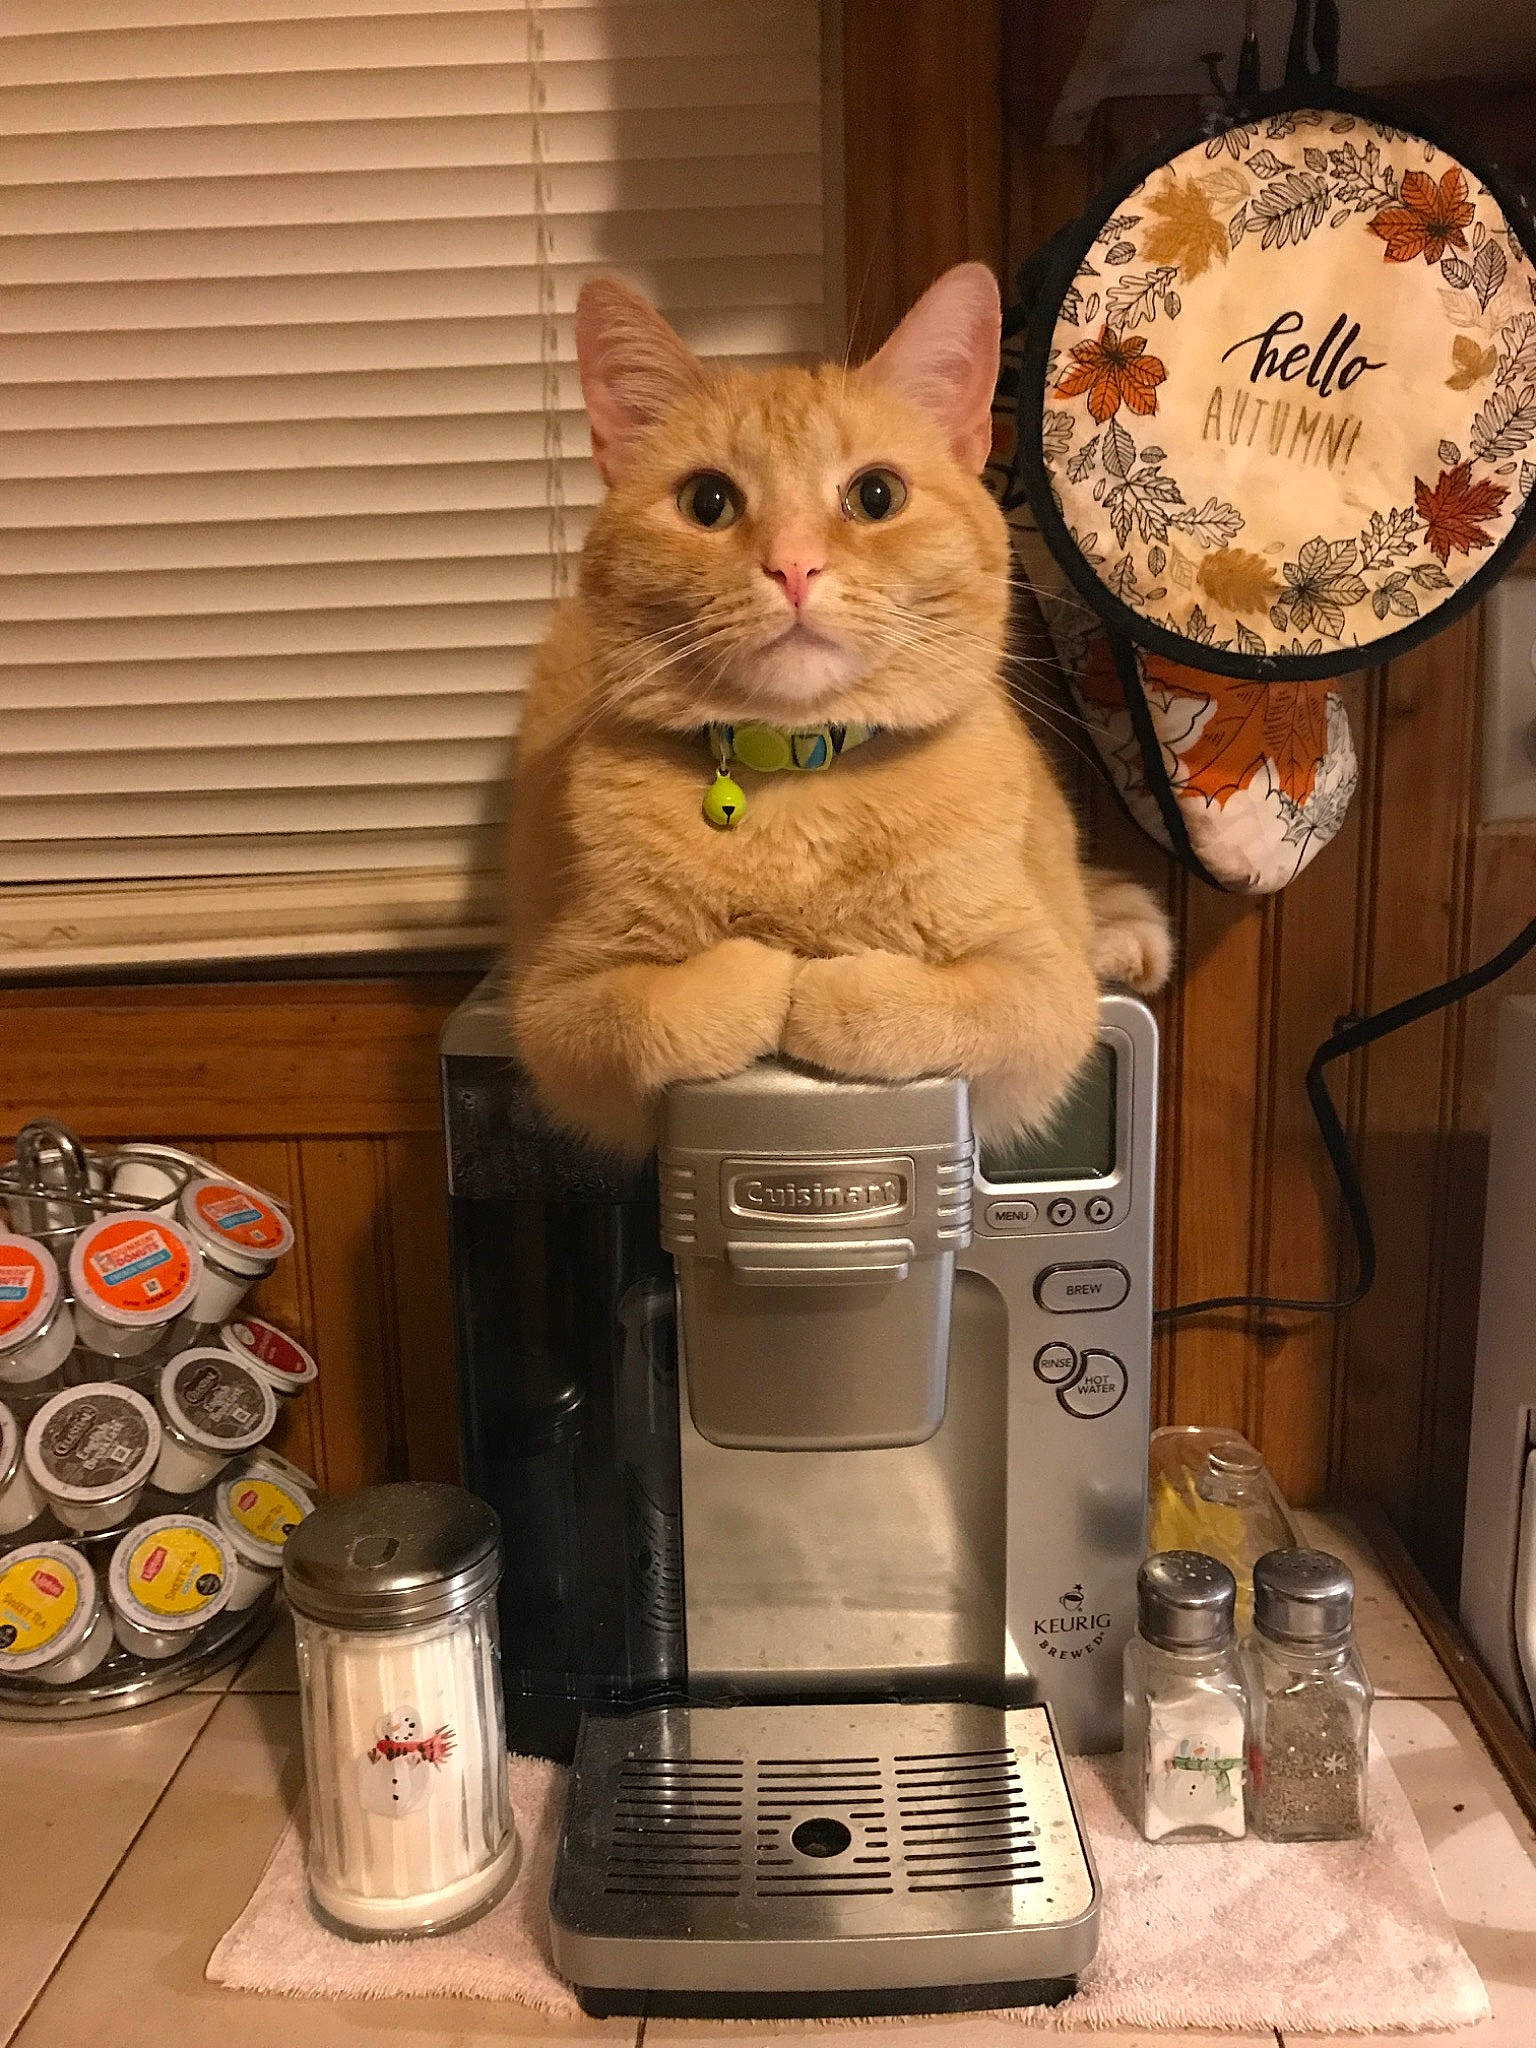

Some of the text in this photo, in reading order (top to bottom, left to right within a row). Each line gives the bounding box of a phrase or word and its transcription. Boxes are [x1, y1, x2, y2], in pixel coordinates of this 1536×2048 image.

[1221, 311, 1387, 397] hello
[1202, 385, 1363, 475] AUTUMN!
[748, 1181, 897, 1207] Cuisinart
[995, 1210, 1029, 1222] MENU
[1066, 1283, 1103, 1296] BREW
[1040, 1357, 1073, 1369] RINSE
[1085, 1375, 1110, 1385] HOT
[1077, 1383, 1116, 1395] WATER
[1034, 1613, 1111, 1635] KEURIG
[1038, 1635, 1104, 1660] BREWED
